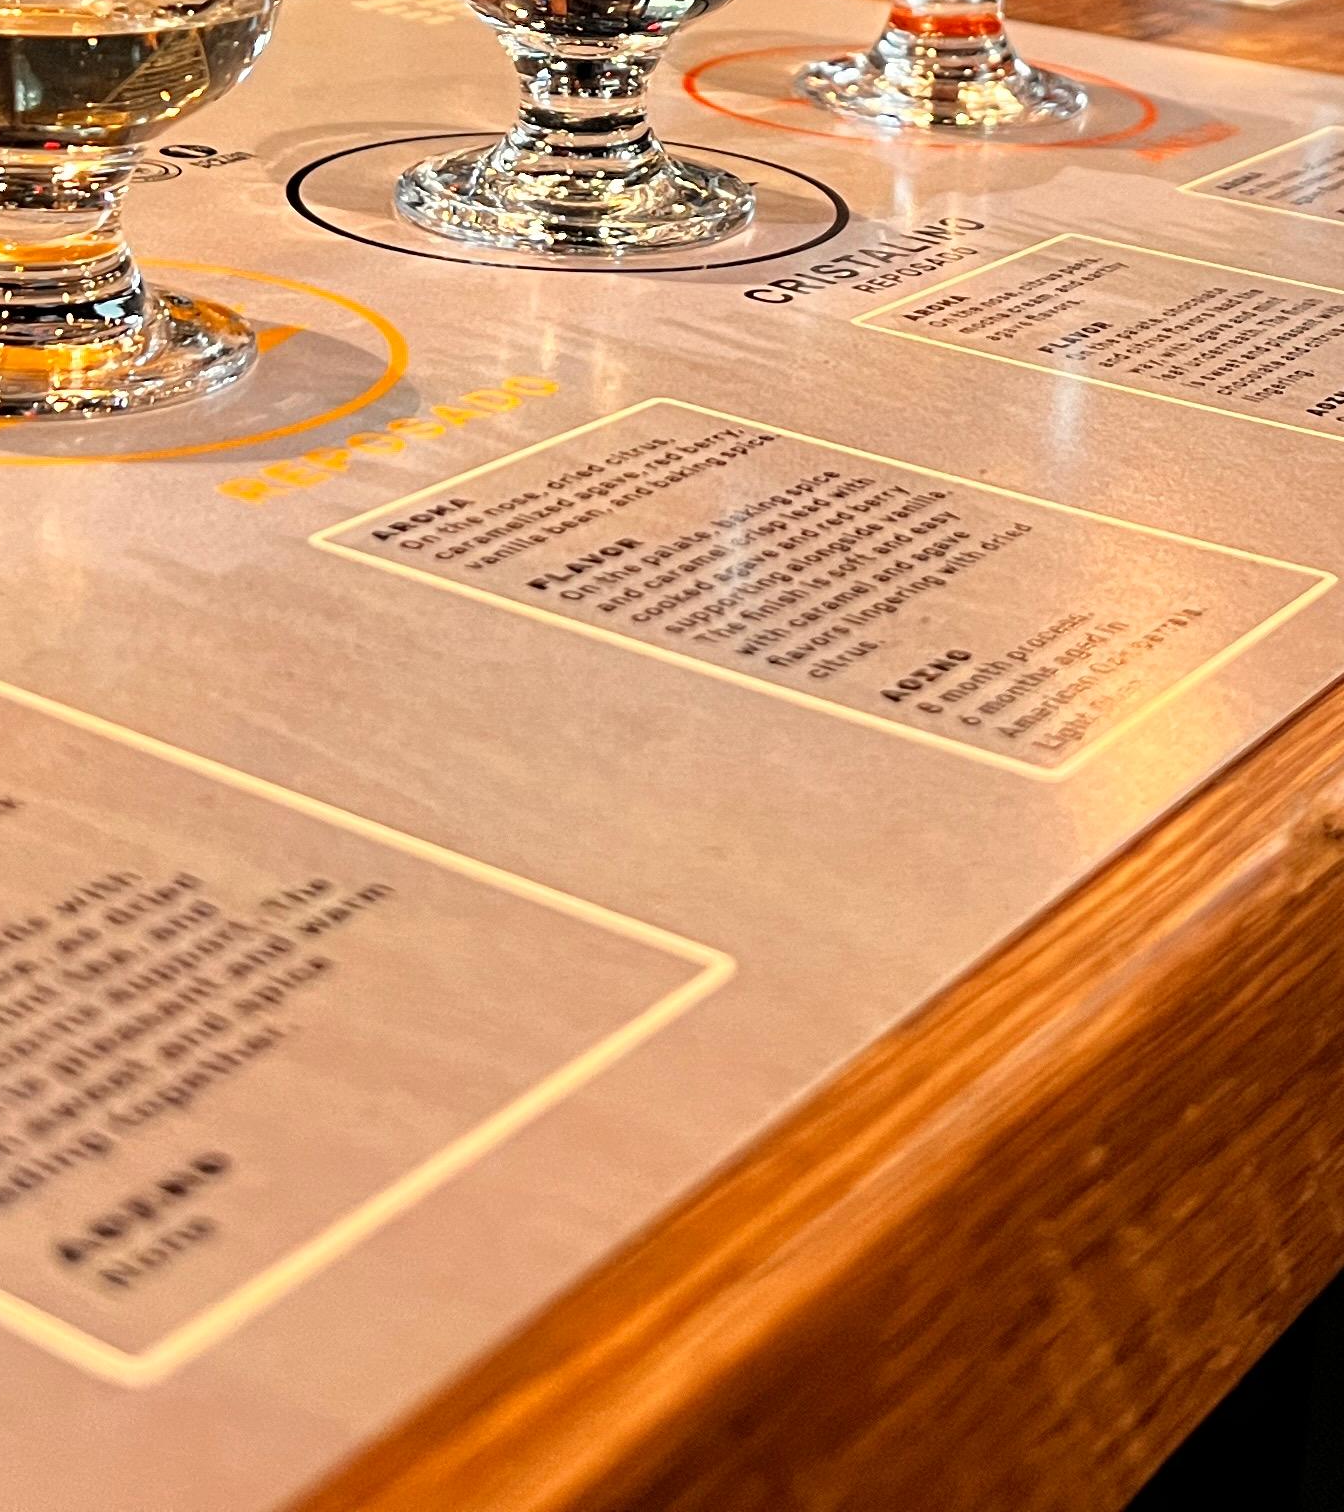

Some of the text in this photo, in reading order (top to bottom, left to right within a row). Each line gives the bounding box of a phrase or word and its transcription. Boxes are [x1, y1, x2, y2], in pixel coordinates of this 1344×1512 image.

[743, 216, 985, 304] CRISTALINO
[851, 245, 978, 294] REPOSADO
[901, 295, 971, 322] AROMA
[1036, 321, 1114, 354] FLAVOR
[215, 374, 560, 504] REPOSADO
[399, 438, 677, 551] On the nose, dried citrus,
[434, 428, 745, 561] caramelized agave, red berry,
[371, 499, 469, 542] AROMA
[464, 434, 782, 570] vanilla bean, and baking spice.
[559, 471, 841, 601] On the palate, baking spice
[596, 478, 876, 614] and caramel crisp lead with
[630, 485, 911, 624] cooked agave and red berry
[526, 538, 643, 591] FLAVOR
[664, 491, 953, 635] supporting alongside vanilla.
[691, 622, 748, 644] The
[739, 589, 810, 622] finish
[827, 553, 877, 579] soft
[871, 532, 914, 555] and
[909, 511, 961, 535] easy
[735, 531, 971, 656] with caramel and agave
[765, 522, 1033, 668] flavors lingering with dried
[807, 640, 886, 680] citrus.
[881, 650, 972, 703] AGING
[937, 660, 1014, 703] month
[977, 666, 1059, 716] months
[1053, 632, 1109, 667] aged
